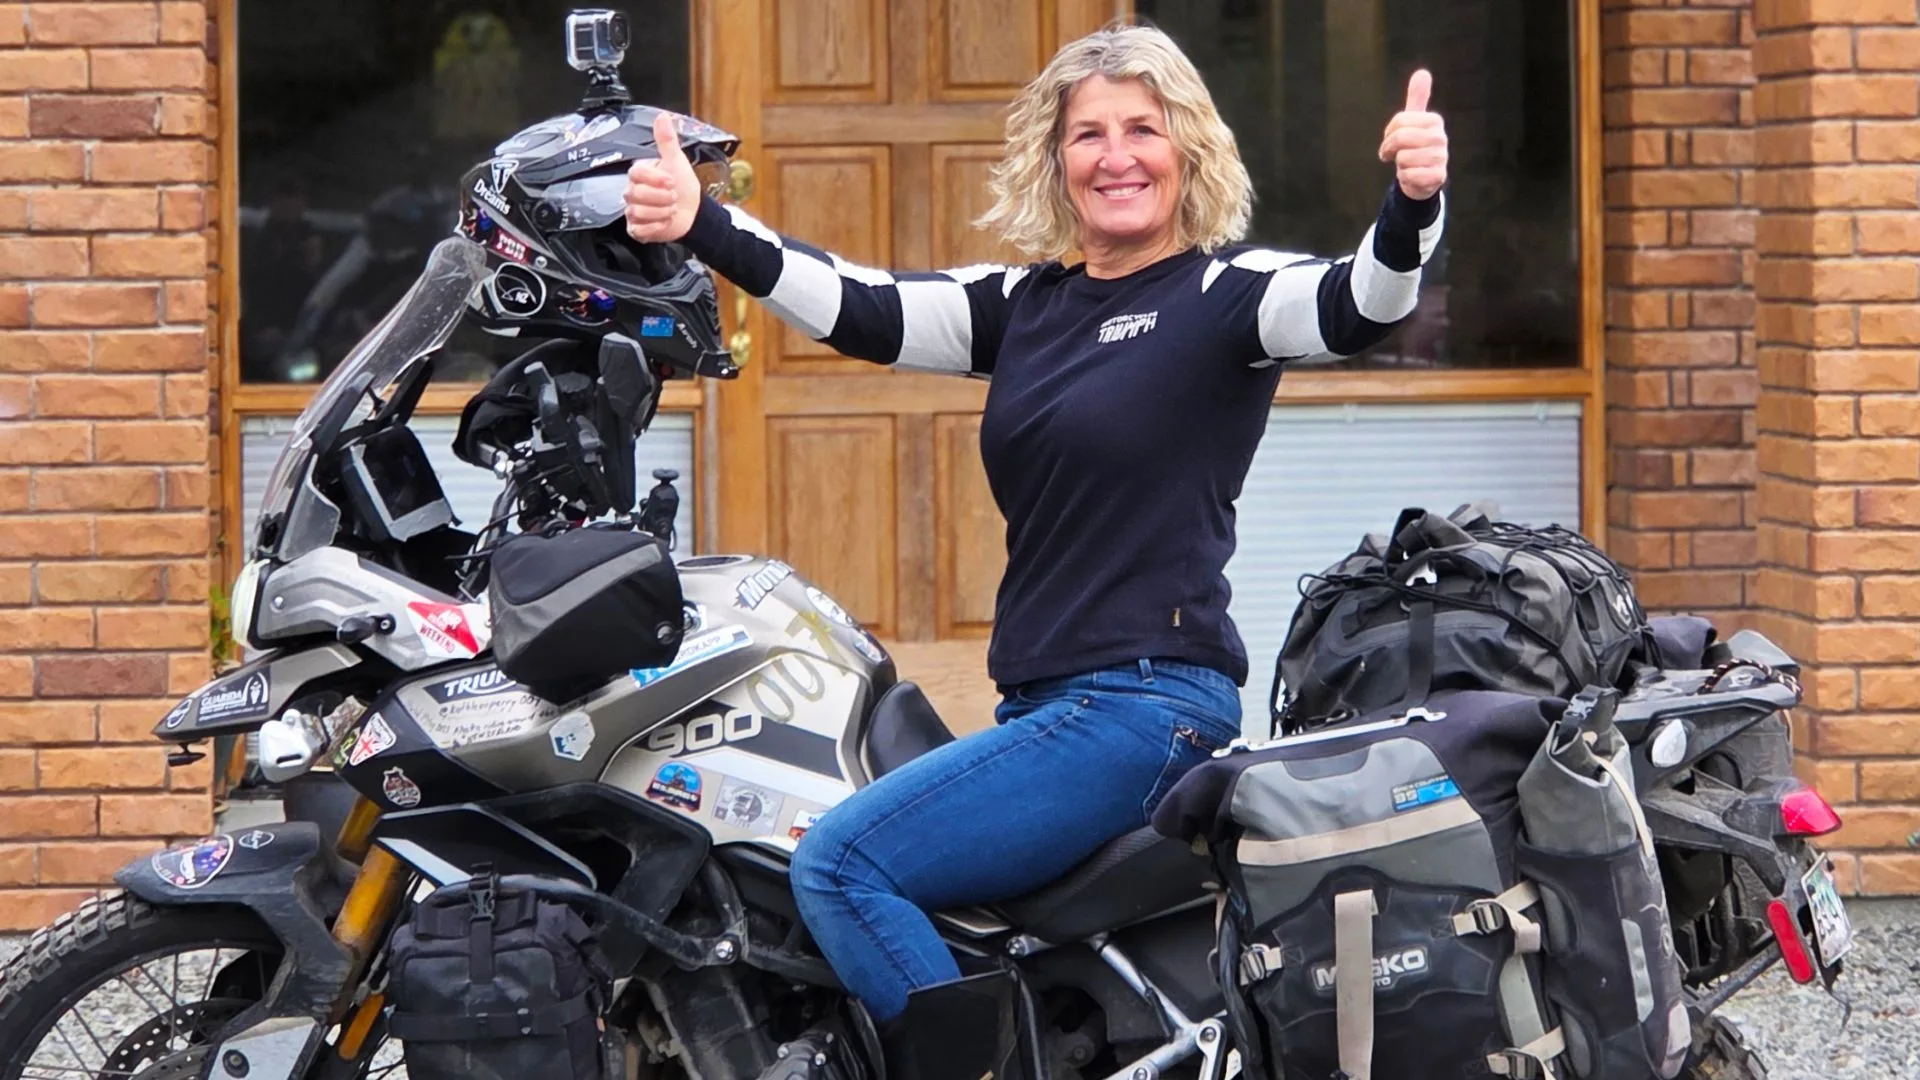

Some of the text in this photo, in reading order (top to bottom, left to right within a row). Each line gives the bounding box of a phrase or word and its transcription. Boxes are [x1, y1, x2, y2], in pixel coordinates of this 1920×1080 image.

[473, 178, 511, 215] Dreams
[1097, 317, 1158, 344] TRIUMPH
[648, 709, 762, 757] 900
[1316, 949, 1425, 987] MSKO
